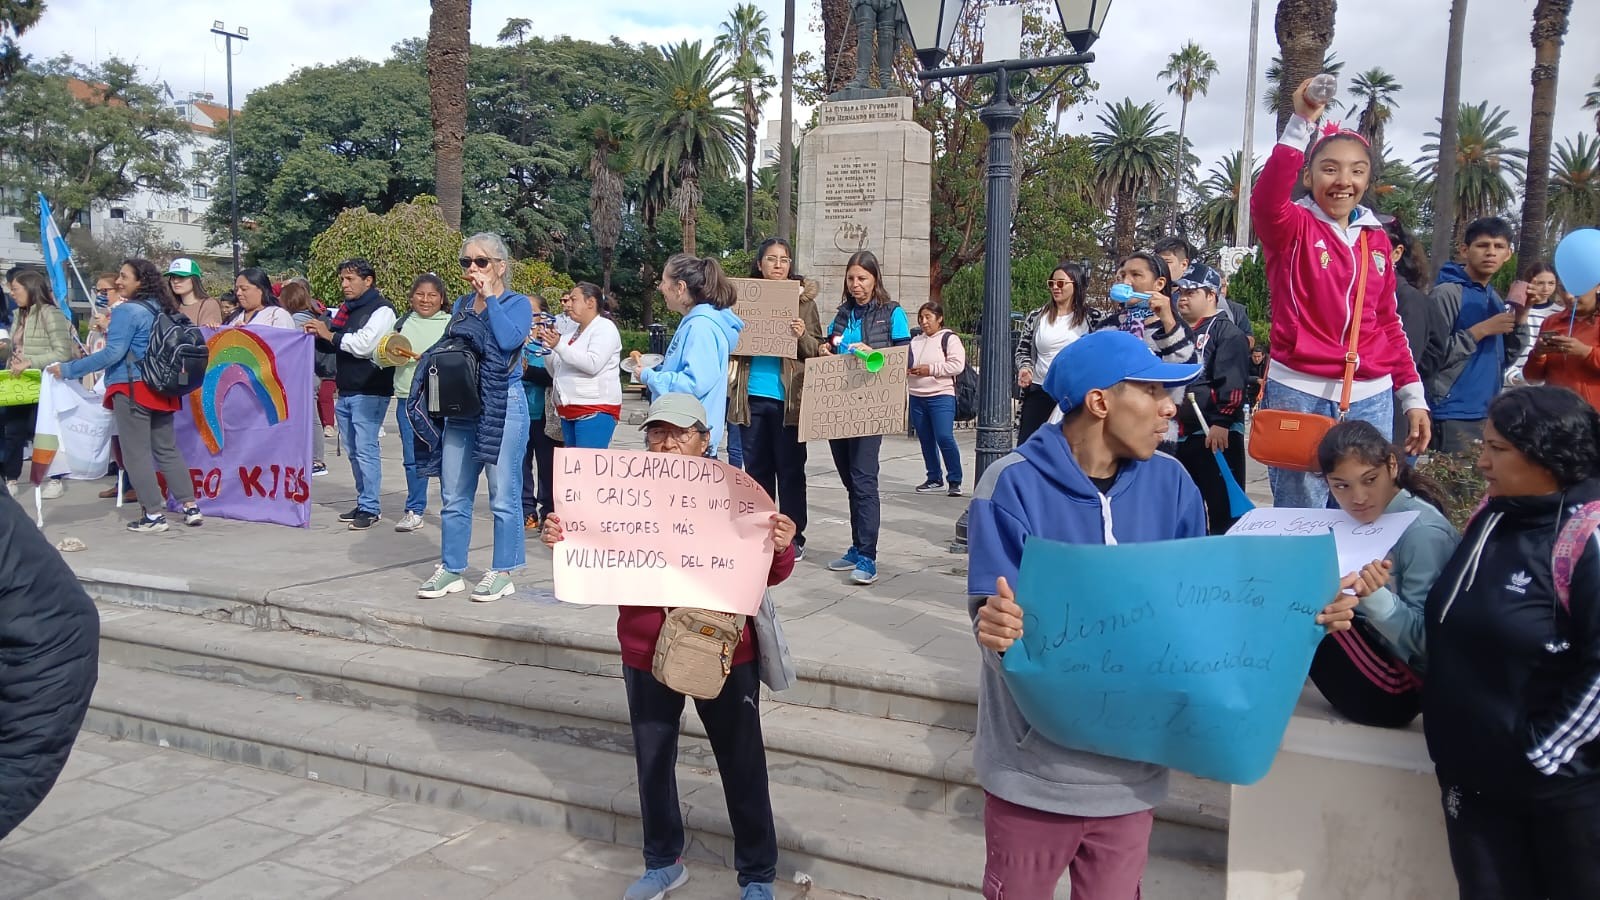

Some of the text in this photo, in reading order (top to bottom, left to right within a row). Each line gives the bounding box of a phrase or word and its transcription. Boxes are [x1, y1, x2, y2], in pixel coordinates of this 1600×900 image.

[867, 404, 902, 420] SEGUIR
[564, 456, 582, 474] LA
[595, 454, 725, 484] DISCAPACIDAD
[565, 488, 581, 502] EN
[596, 488, 652, 508] CRISIS
[708, 498, 731, 510] UNO
[738, 500, 755, 514] DE
[565, 518, 696, 536] LOS SECTORES MÁS
[566, 548, 668, 570] VULNERADOS
[682, 555, 704, 568] DEL
